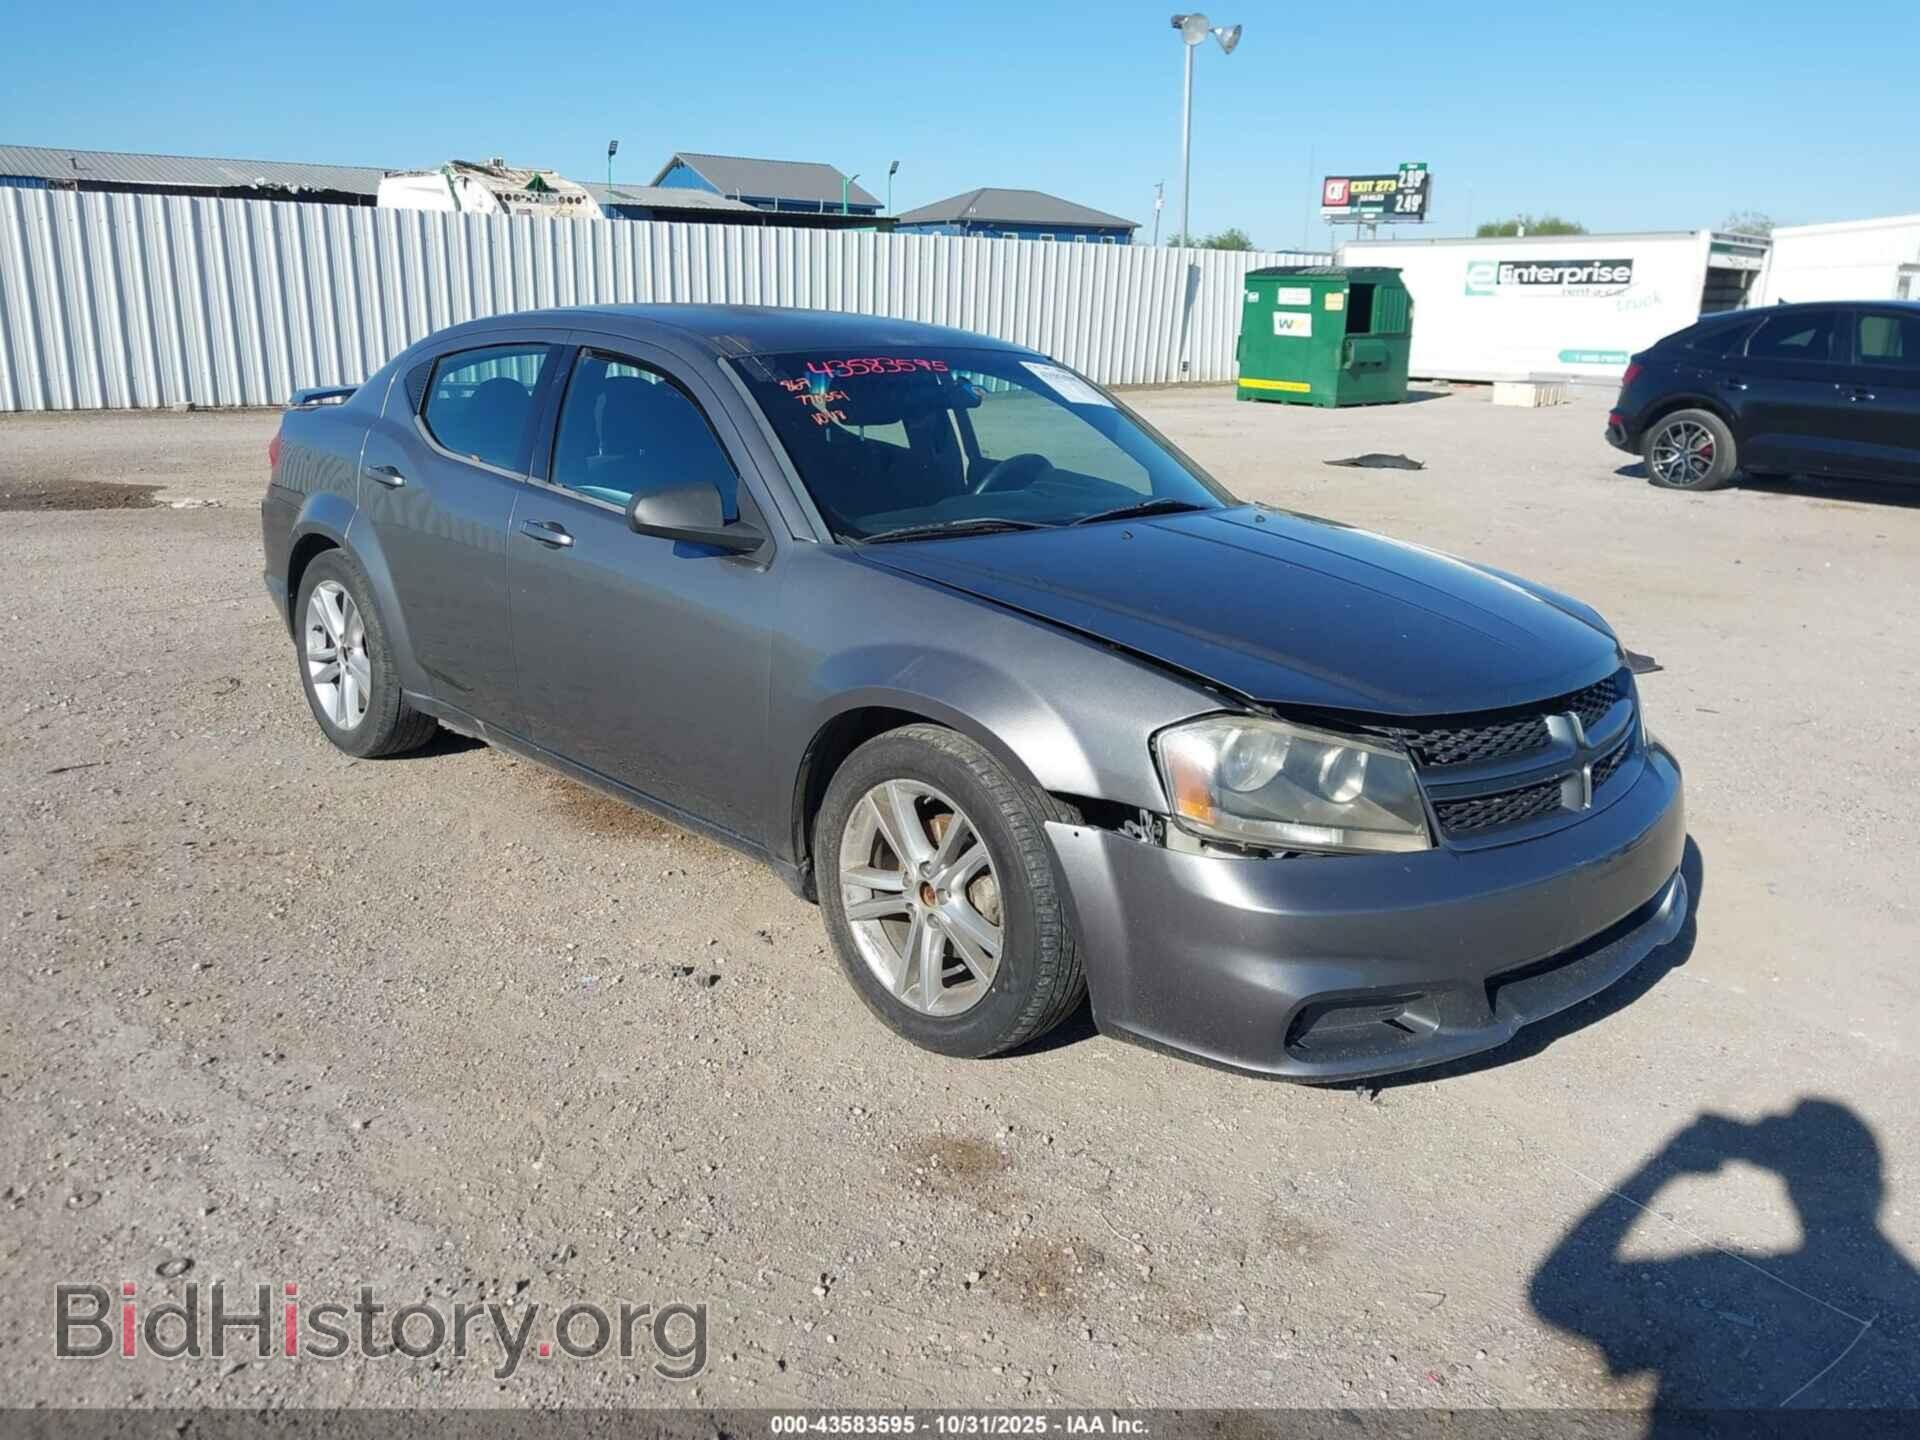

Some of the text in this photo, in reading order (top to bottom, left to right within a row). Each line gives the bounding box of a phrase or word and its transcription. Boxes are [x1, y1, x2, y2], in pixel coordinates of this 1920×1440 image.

[1350, 181, 1375, 193] EXIT
[1375, 180, 1397, 192] 273
[1499, 262, 1631, 286] Enterprise
[807, 356, 948, 378] 43583595
